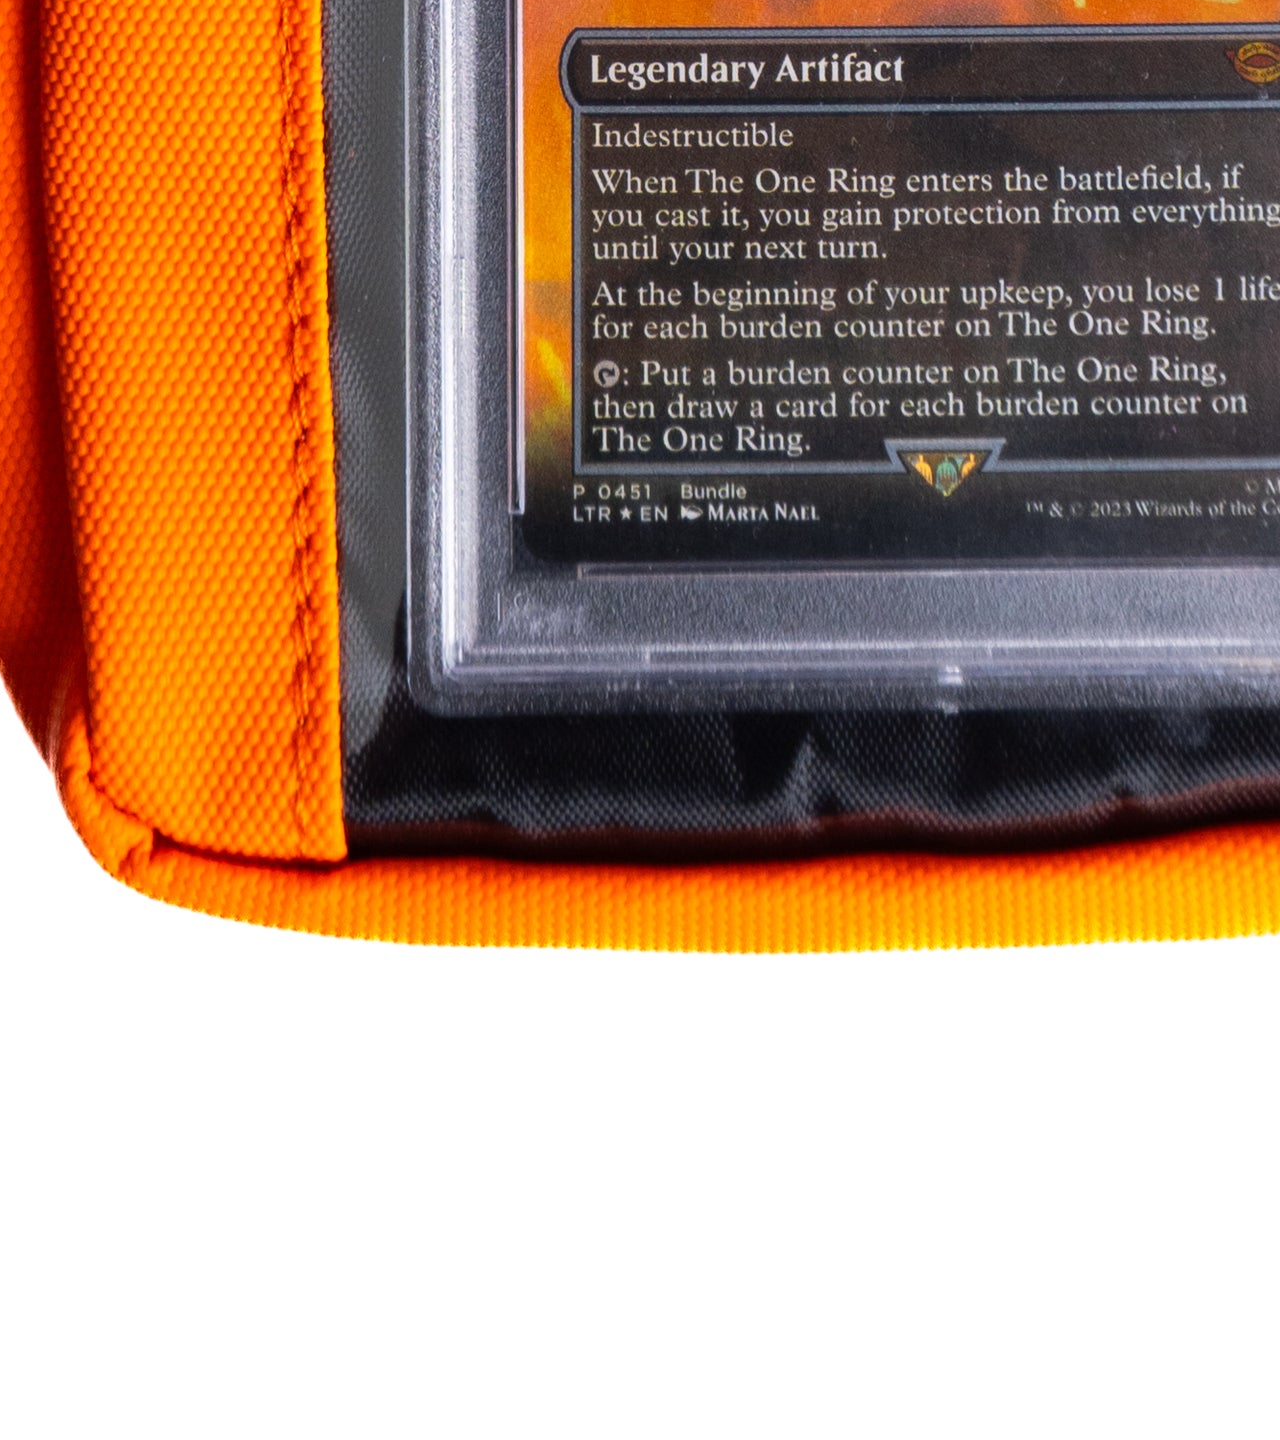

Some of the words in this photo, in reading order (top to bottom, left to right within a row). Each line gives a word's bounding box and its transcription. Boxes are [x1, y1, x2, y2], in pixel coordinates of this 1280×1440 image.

[591, 53, 766, 91] Legendary
[775, 52, 905, 83] Artifact
[592, 122, 794, 148] Indestructible
[592, 168, 678, 194] When
[685, 168, 744, 194] The
[755, 167, 816, 194] One
[827, 167, 896, 199] Ring
[906, 172, 993, 193] enters
[1004, 166, 1049, 192] the
[1059, 164, 1212, 193] battlefield,
[1221, 164, 1245, 190] if
[592, 207, 644, 232] you
[655, 206, 711, 227] cast
[721, 201, 750, 231] it,
[759, 208, 812, 232] you
[822, 201, 883, 232] gain
[892, 199, 1041, 232] protection
[1052, 198, 1121, 224] from
[592, 235, 659, 260] until
[669, 241, 735, 265] your
[744, 238, 807, 260] next
[817, 237, 888, 259] turn.
[591, 280, 627, 307] At
[638, 280, 682, 307] the
[692, 280, 837, 311] beginning
[846, 279, 879, 306] of
[884, 286, 950, 310] your
[960, 278, 1073, 310] upkeep,
[1083, 285, 1134, 309] you
[1144, 277, 1201, 303] lose
[1215, 276, 1225, 302] 1
[593, 313, 634, 340] for
[643, 313, 709, 340] each
[719, 312, 823, 339] burden
[833, 316, 945, 338] counter
[955, 317, 992, 337] on
[998, 310, 1058, 337] The
[1068, 310, 1130, 336] One
[1142, 309, 1217, 341] Ring.
[640, 359, 691, 386] Put
[702, 367, 717, 387] a
[727, 359, 832, 386] burden
[842, 363, 954, 385] counter
[963, 364, 1000, 384] on
[1006, 357, 1066, 383] The
[1076, 356, 1138, 383] One
[1149, 355, 1227, 387] Ring,
[593, 392, 656, 419] then
[667, 392, 739, 419] draw
[749, 399, 765, 419] a
[775, 391, 838, 419] card
[849, 390, 891, 418] for
[900, 390, 966, 418] each
[976, 389, 1079, 417] burden
[1090, 393, 1202, 416] counter
[1211, 393, 1248, 414] on
[592, 425, 652, 452] The
[662, 425, 724, 452] One
[735, 425, 811, 457] Ring.
[573, 483, 586, 500] P
[598, 483, 652, 500] 0451
[680, 482, 747, 500] Bundle
[572, 505, 611, 522] LTR
[639, 505, 669, 522] EN
[1090, 500, 1132, 518] 2023
[1135, 499, 1203, 518] Wizards
[1207, 499, 1227, 518] of
[1230, 499, 1257, 516] the
